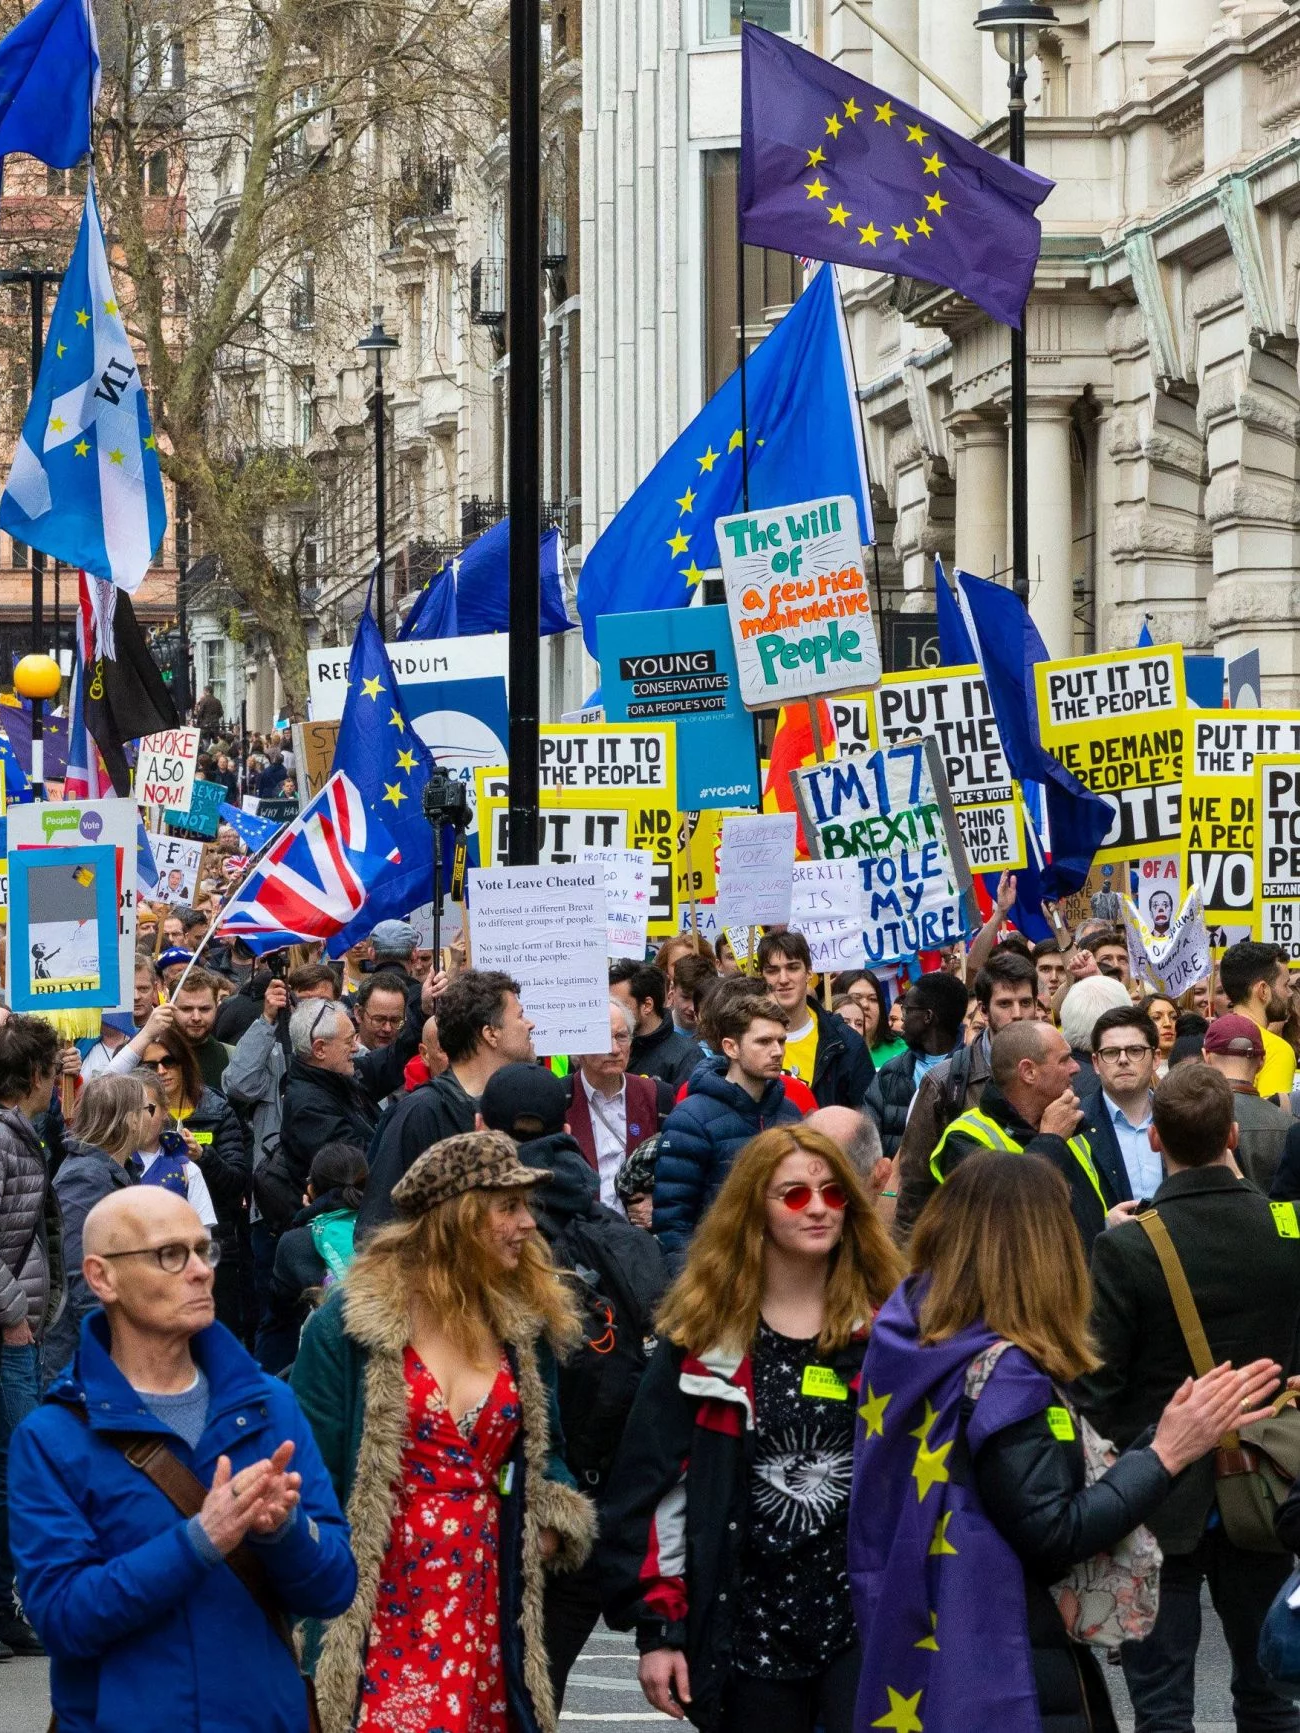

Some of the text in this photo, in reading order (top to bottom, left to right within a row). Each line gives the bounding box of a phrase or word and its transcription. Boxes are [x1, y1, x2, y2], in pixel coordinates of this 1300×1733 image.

[724, 502, 841, 557] The Will
[771, 545, 802, 576] of
[743, 567, 863, 618] a few rich
[740, 593, 869, 639] manipulative
[756, 621, 862, 685] People
[907, 636, 940, 668] 16
[626, 653, 709, 677] YOUNG
[632, 676, 730, 695] CONSERVATIVES
[1050, 660, 1169, 700] PUT IT TO
[626, 697, 726, 715] FOR A PEOPLE'S VOTE
[880, 680, 992, 726] PUT IT
[1052, 686, 1171, 721] THE PEOPLE
[143, 730, 196, 758] REVOKE
[935, 718, 999, 755] THE
[1090, 729, 1183, 765] DEMAND
[1199, 724, 1281, 751] PUT IT
[540, 738, 660, 764] PUT IT TO
[146, 757, 184, 782] A50
[1198, 752, 1231, 772] THE
[540, 765, 660, 785] THE PEOPLE
[802, 746, 922, 824] I'M 17
[144, 784, 184, 806] NOW!
[699, 784, 751, 799] #YC4PV
[986, 787, 1011, 800] VOTE
[261, 808, 278, 817] WHY
[1190, 797, 1220, 822] WE
[46, 816, 100, 830] People's Vote
[178, 812, 209, 831] NOT
[585, 816, 619, 848] IT
[821, 804, 943, 859] BREXIT
[999, 826, 1008, 843] A
[1189, 826, 1202, 848] A
[584, 853, 617, 862] PROTECT
[624, 853, 644, 865] THE
[736, 847, 782, 863] VOTE?
[972, 846, 1009, 863] VOTE
[792, 864, 844, 881] BREXIT
[858, 841, 942, 891] TOLE
[1143, 860, 1178, 878] OF A
[477, 875, 595, 891] Vote Leave Cheated
[478, 906, 522, 916] Advertised
[531, 905, 566, 913] different
[568, 904, 593, 912] Brexit
[808, 891, 832, 909] IS
[871, 883, 924, 921] MY
[478, 920, 486, 928] to
[488, 918, 523, 928] different
[526, 918, 553, 927] groups
[555, 916, 565, 924] of
[1271, 923, 1292, 941] TO
[480, 939, 598, 953] No single form of Brexit has
[495, 955, 511, 963] will
[514, 954, 523, 962] of
[525, 954, 538, 962] the
[533, 977, 554, 986] lacks
[556, 976, 599, 987] legitimacy
[526, 1002, 545, 1010] must
[547, 1002, 566, 1011] keep
